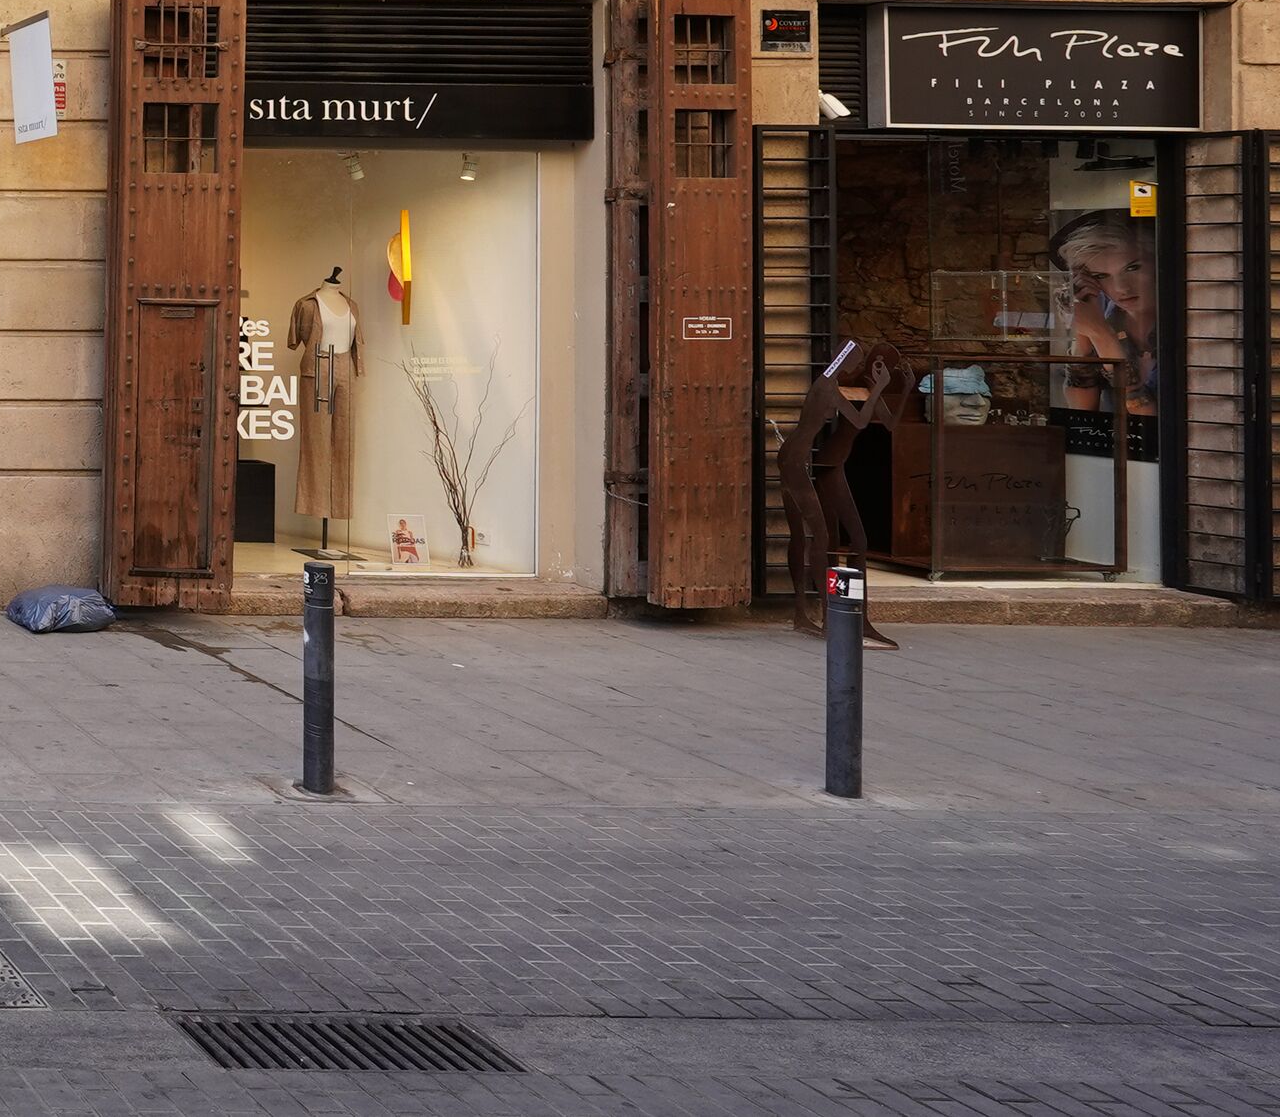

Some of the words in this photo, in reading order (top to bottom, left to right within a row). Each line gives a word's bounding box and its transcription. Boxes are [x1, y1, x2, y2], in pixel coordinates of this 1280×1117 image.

[931, 78, 1005, 89] FILI
[1045, 79, 1155, 90] PLAZA
[966, 97, 1120, 107] BARCELONA
[321, 93, 437, 129] murt/
[968, 109, 1040, 118] SINCE
[1063, 110, 1119, 119] 2003
[240, 375, 297, 406] BAI
